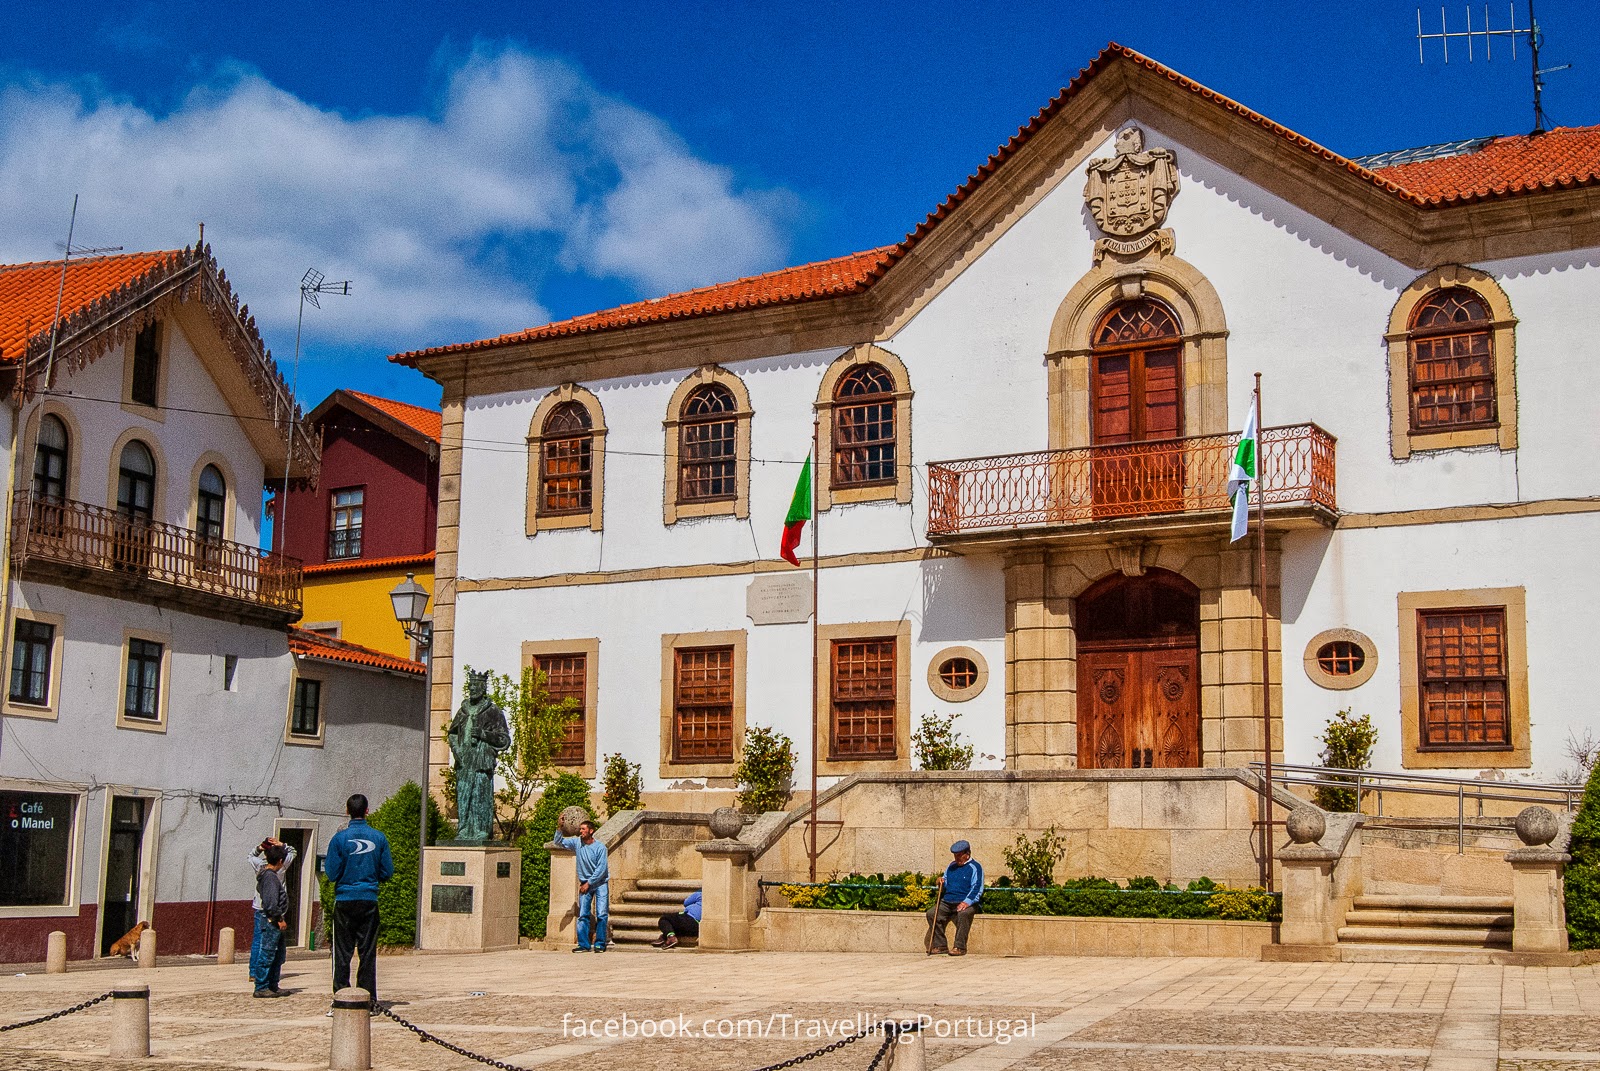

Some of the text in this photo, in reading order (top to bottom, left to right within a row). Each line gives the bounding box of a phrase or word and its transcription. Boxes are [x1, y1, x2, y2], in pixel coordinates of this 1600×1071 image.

[1122, 234, 1156, 252] MUNICIPAL
[21, 801, 43, 813] Café
[11, 817, 54, 829] o Manel
